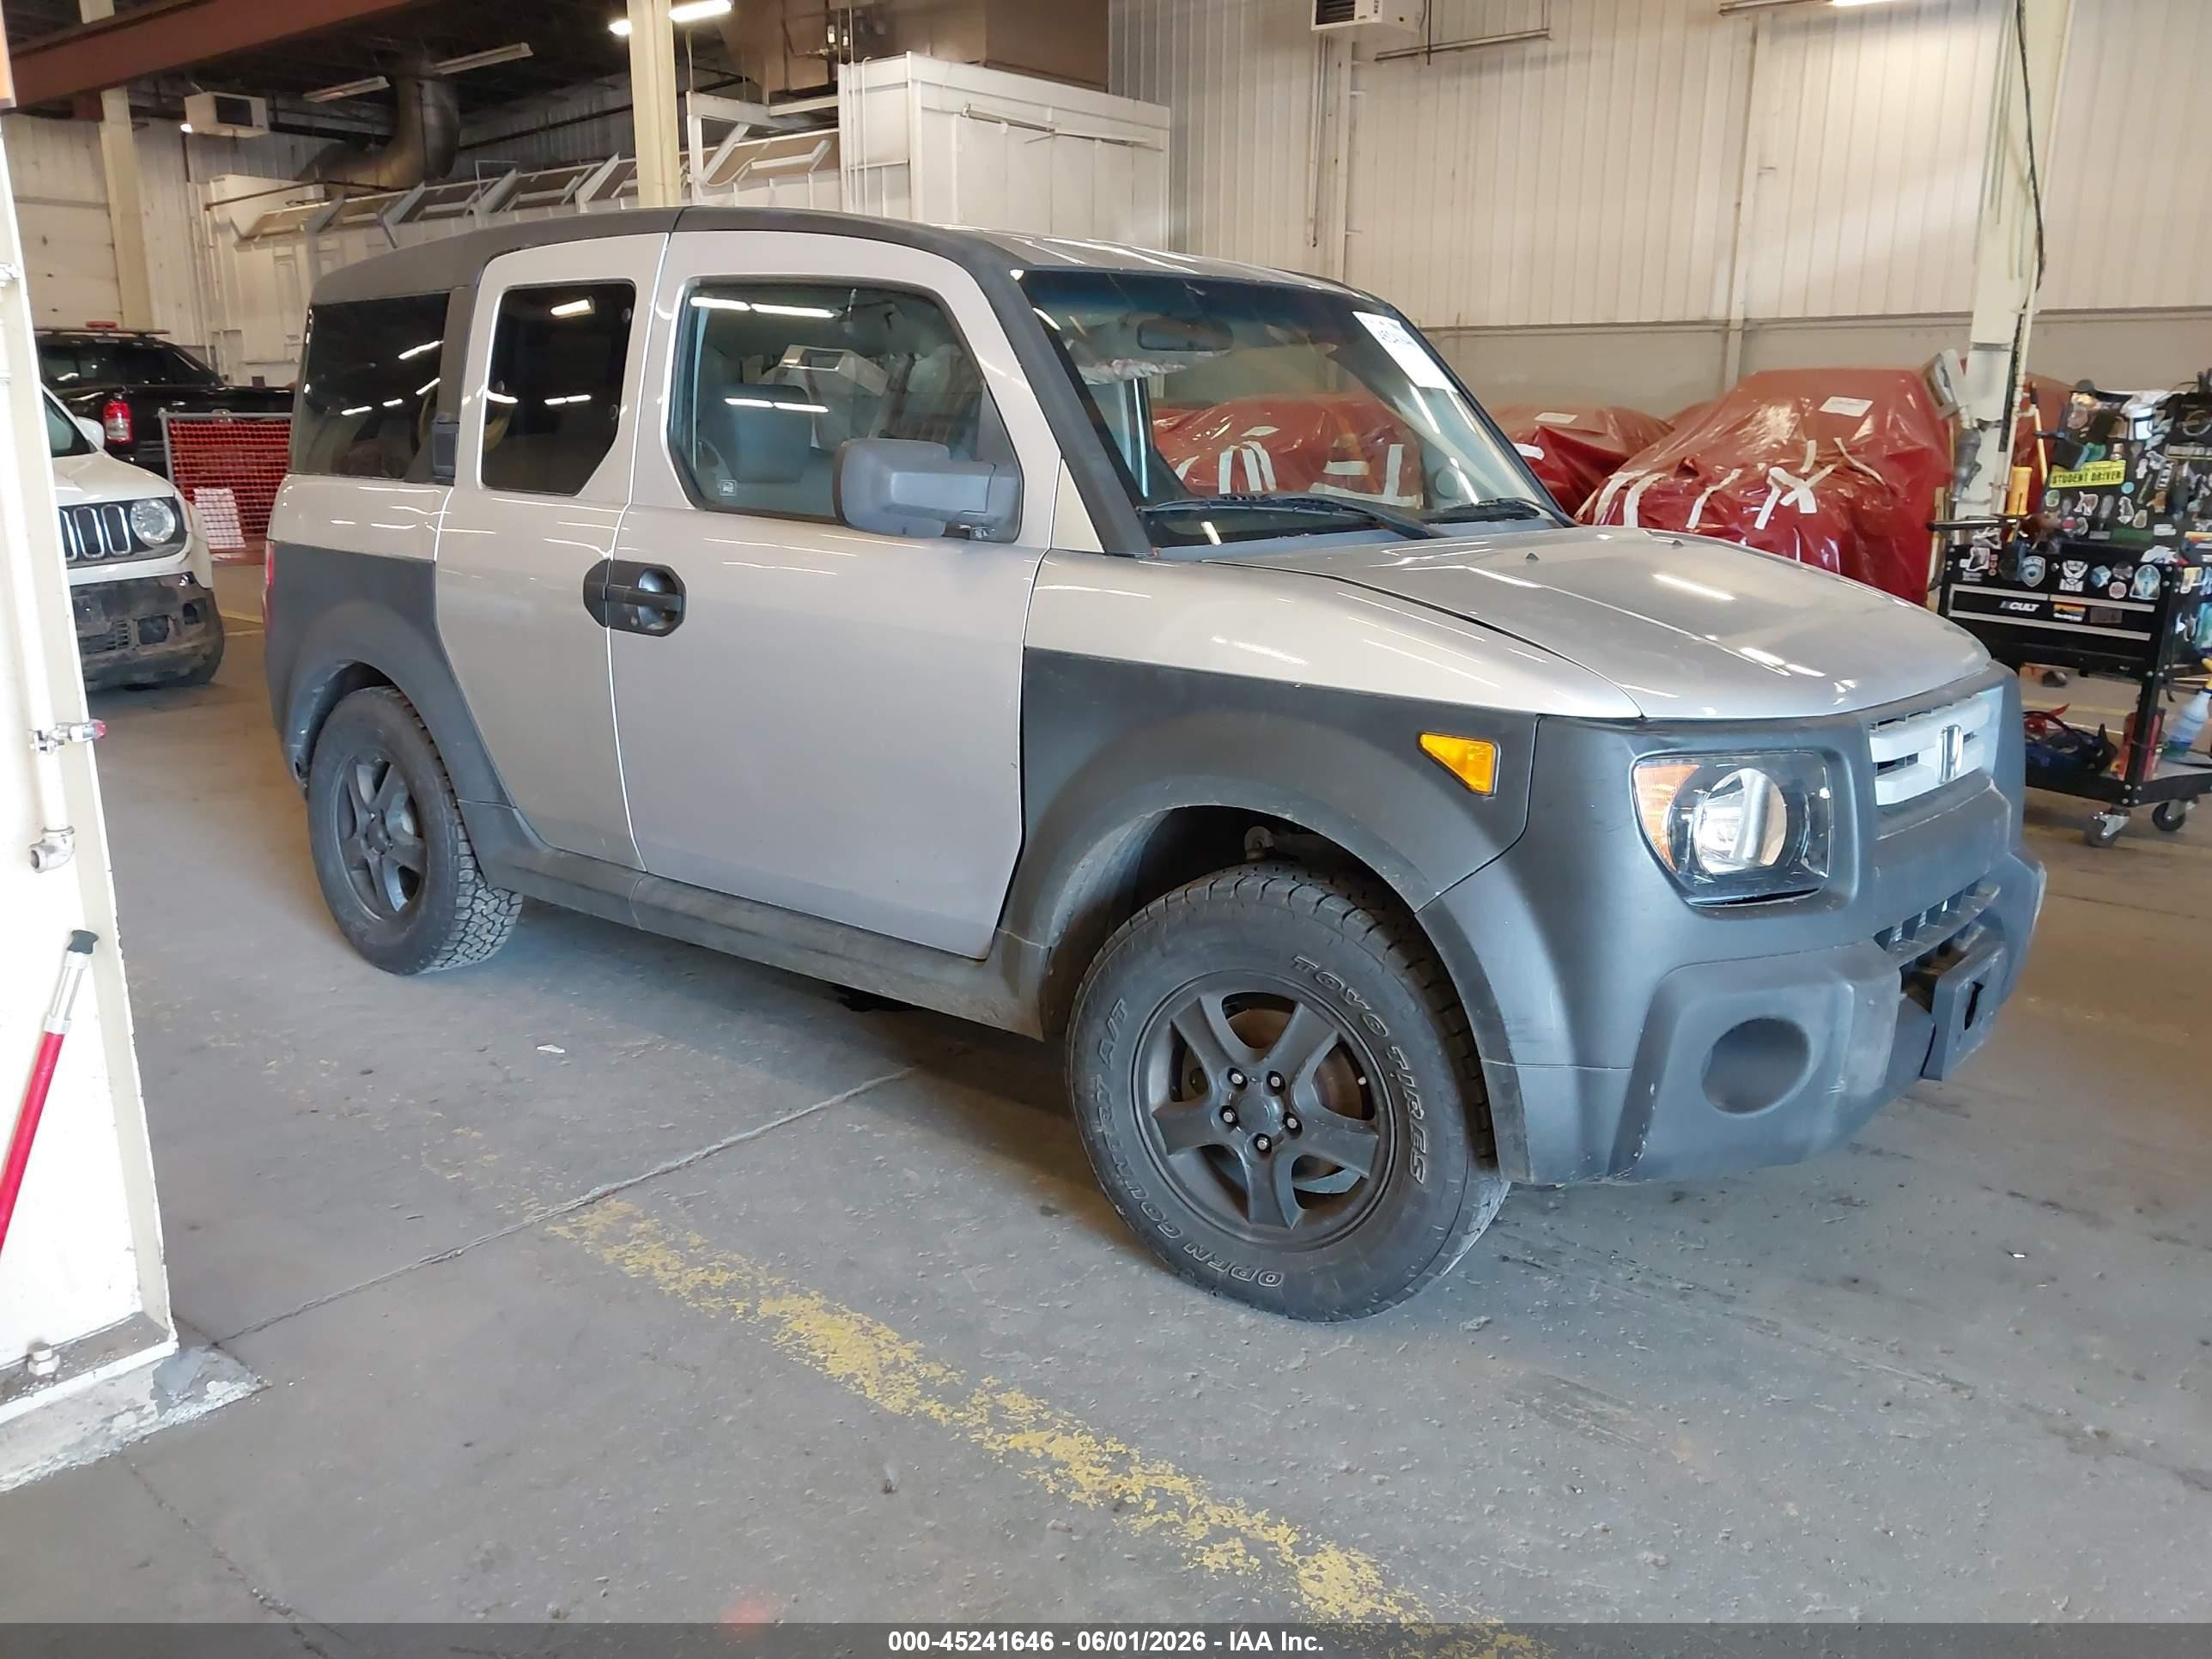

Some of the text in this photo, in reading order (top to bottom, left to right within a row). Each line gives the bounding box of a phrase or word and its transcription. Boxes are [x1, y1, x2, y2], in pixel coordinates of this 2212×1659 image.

[2052, 471, 2122, 484] STUDENT DRIVER
[1092, 997, 1285, 1287] OPEN COUNTRY A/T
[1291, 955, 1427, 1184] TOYO TIRES
